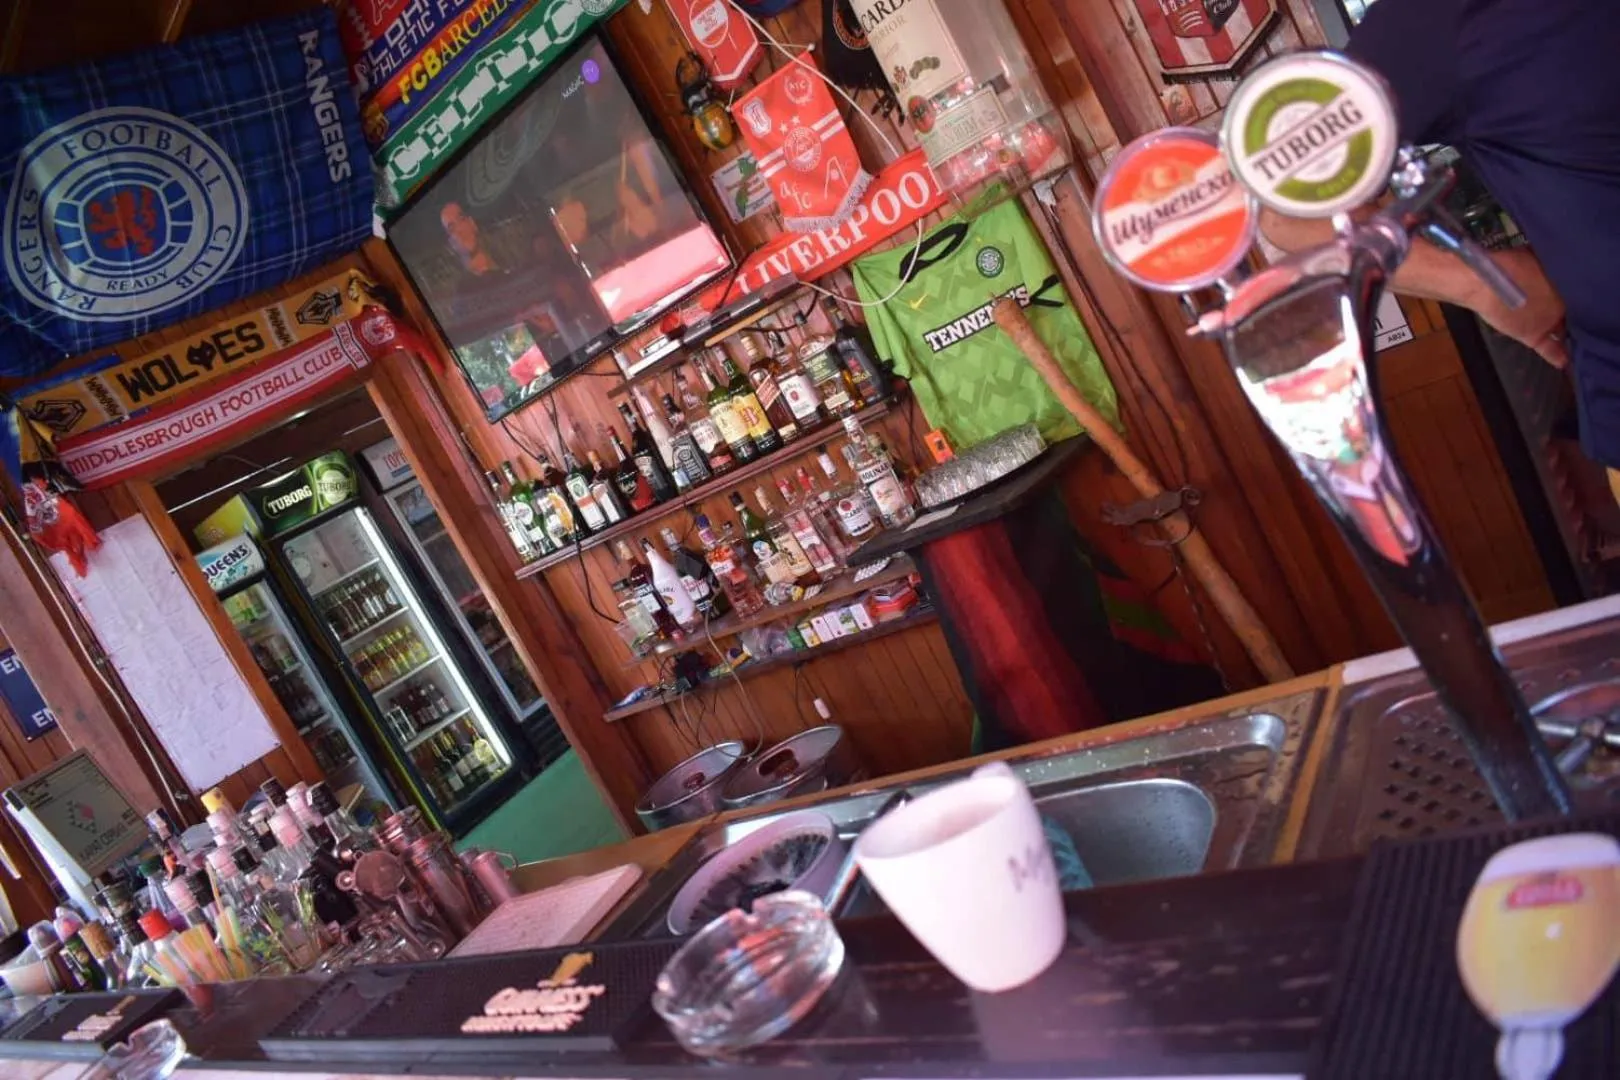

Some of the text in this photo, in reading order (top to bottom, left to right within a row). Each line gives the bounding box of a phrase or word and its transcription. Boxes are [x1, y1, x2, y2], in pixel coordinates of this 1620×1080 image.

[385, 0, 584, 184] CELTIC
[398, 0, 513, 104] FCBARCEL
[299, 28, 352, 185] RANGERS
[1252, 97, 1364, 181] TUBORG
[62, 122, 224, 194] FOOTBALL
[20, 187, 98, 312] RANGERS
[106, 268, 170, 293] READY
[178, 224, 233, 291] CLUB
[67, 345, 344, 475] MIDDLESBROUGH FOOTBALL CLUB
[267, 484, 313, 515] TUBORG
